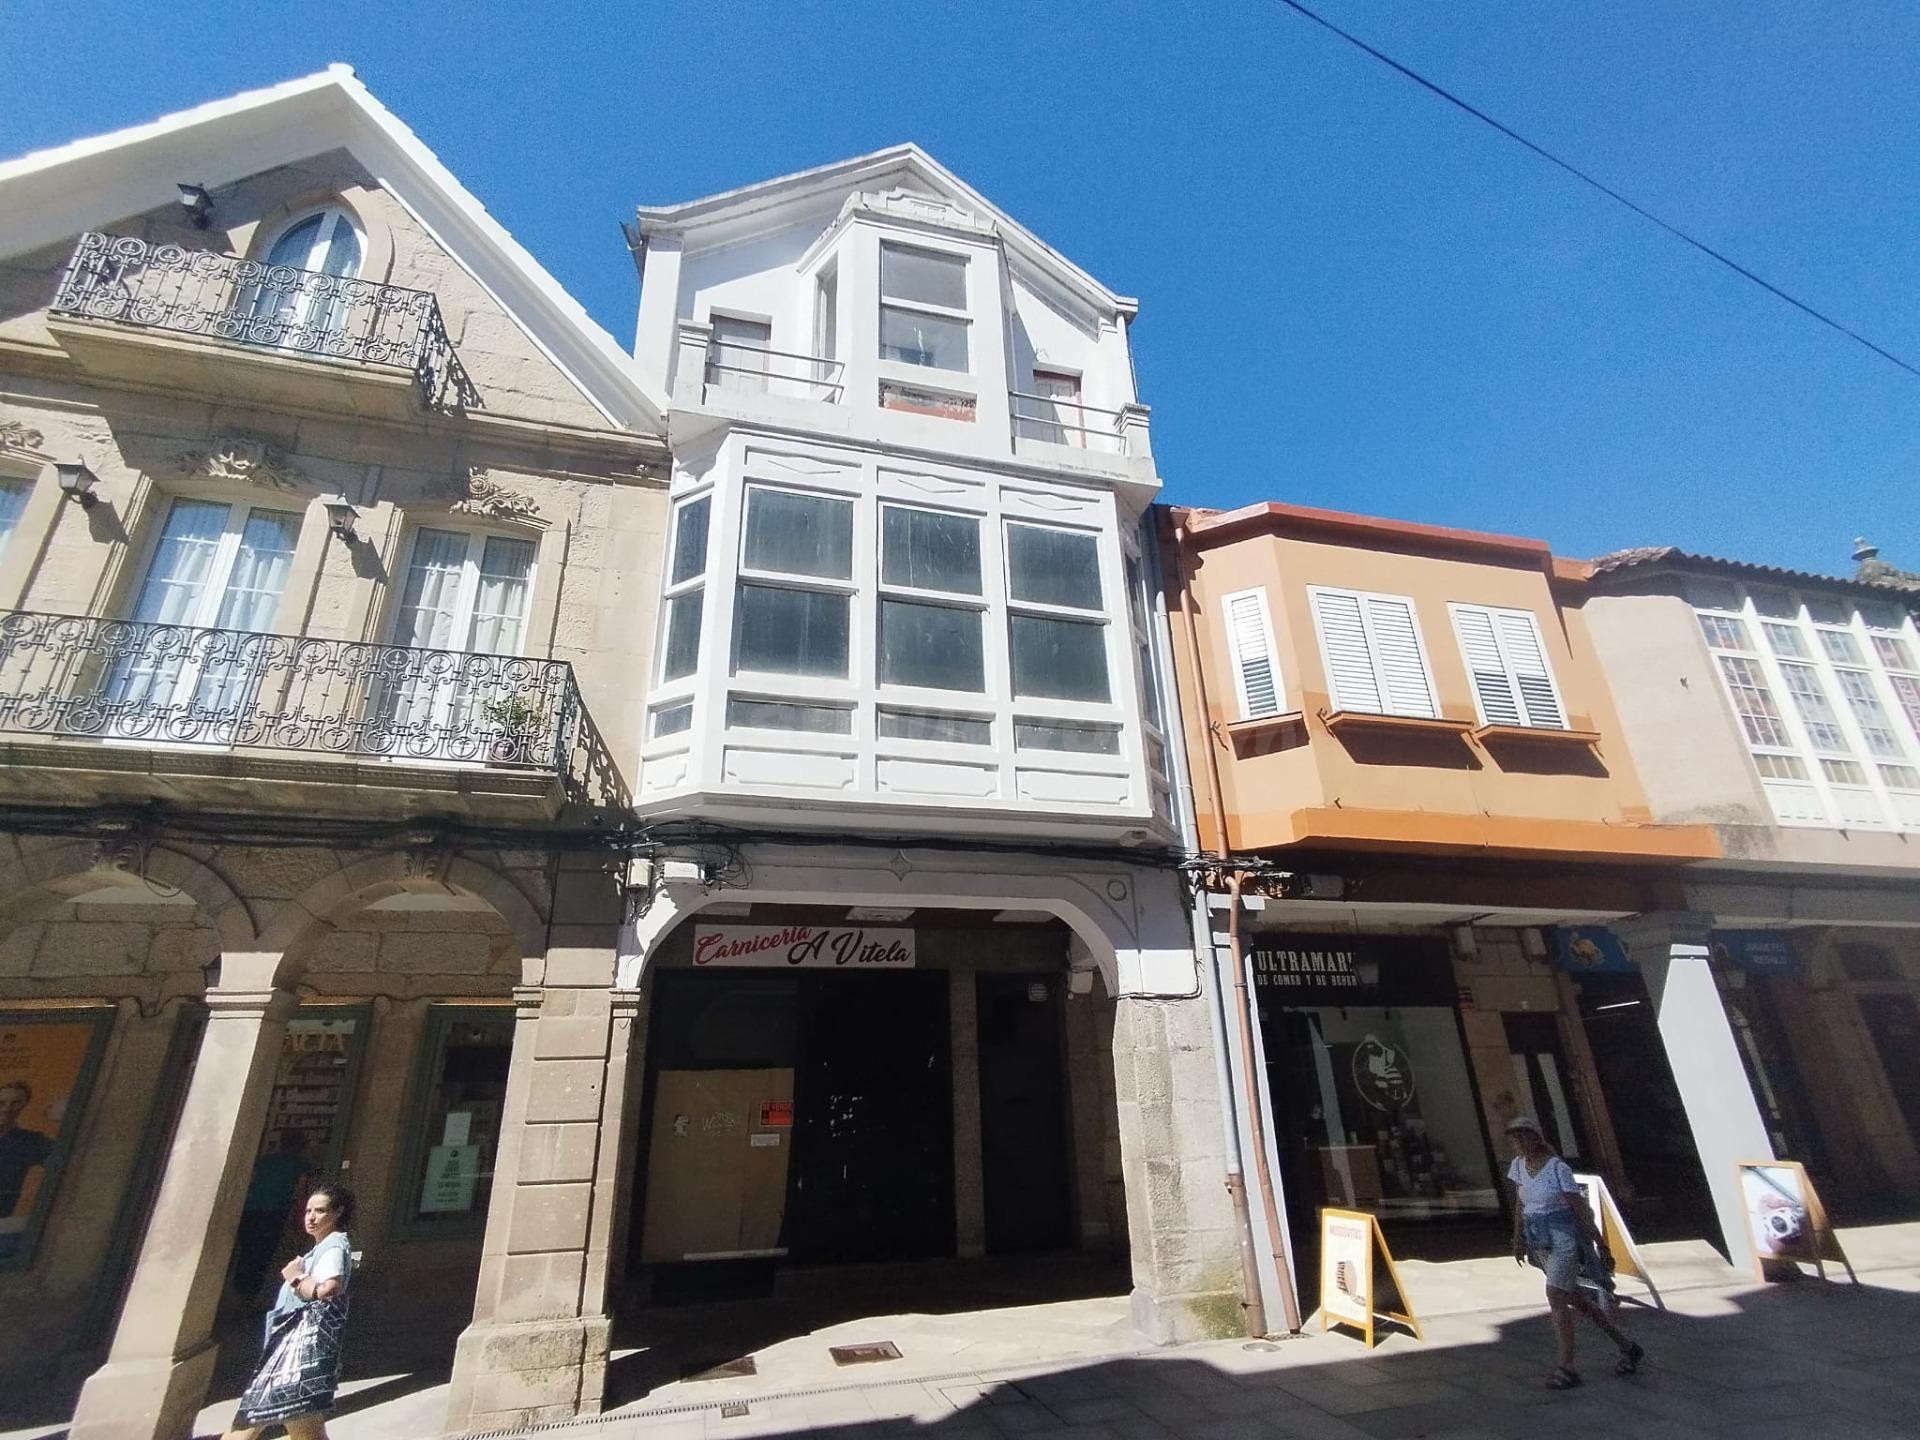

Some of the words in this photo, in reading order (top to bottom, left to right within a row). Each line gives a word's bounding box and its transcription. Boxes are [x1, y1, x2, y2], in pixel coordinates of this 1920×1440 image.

[788, 930, 830, 965] A
[831, 930, 912, 965] Vitela
[1256, 973, 1268, 986] DE
[1316, 974, 1327, 986] DE
